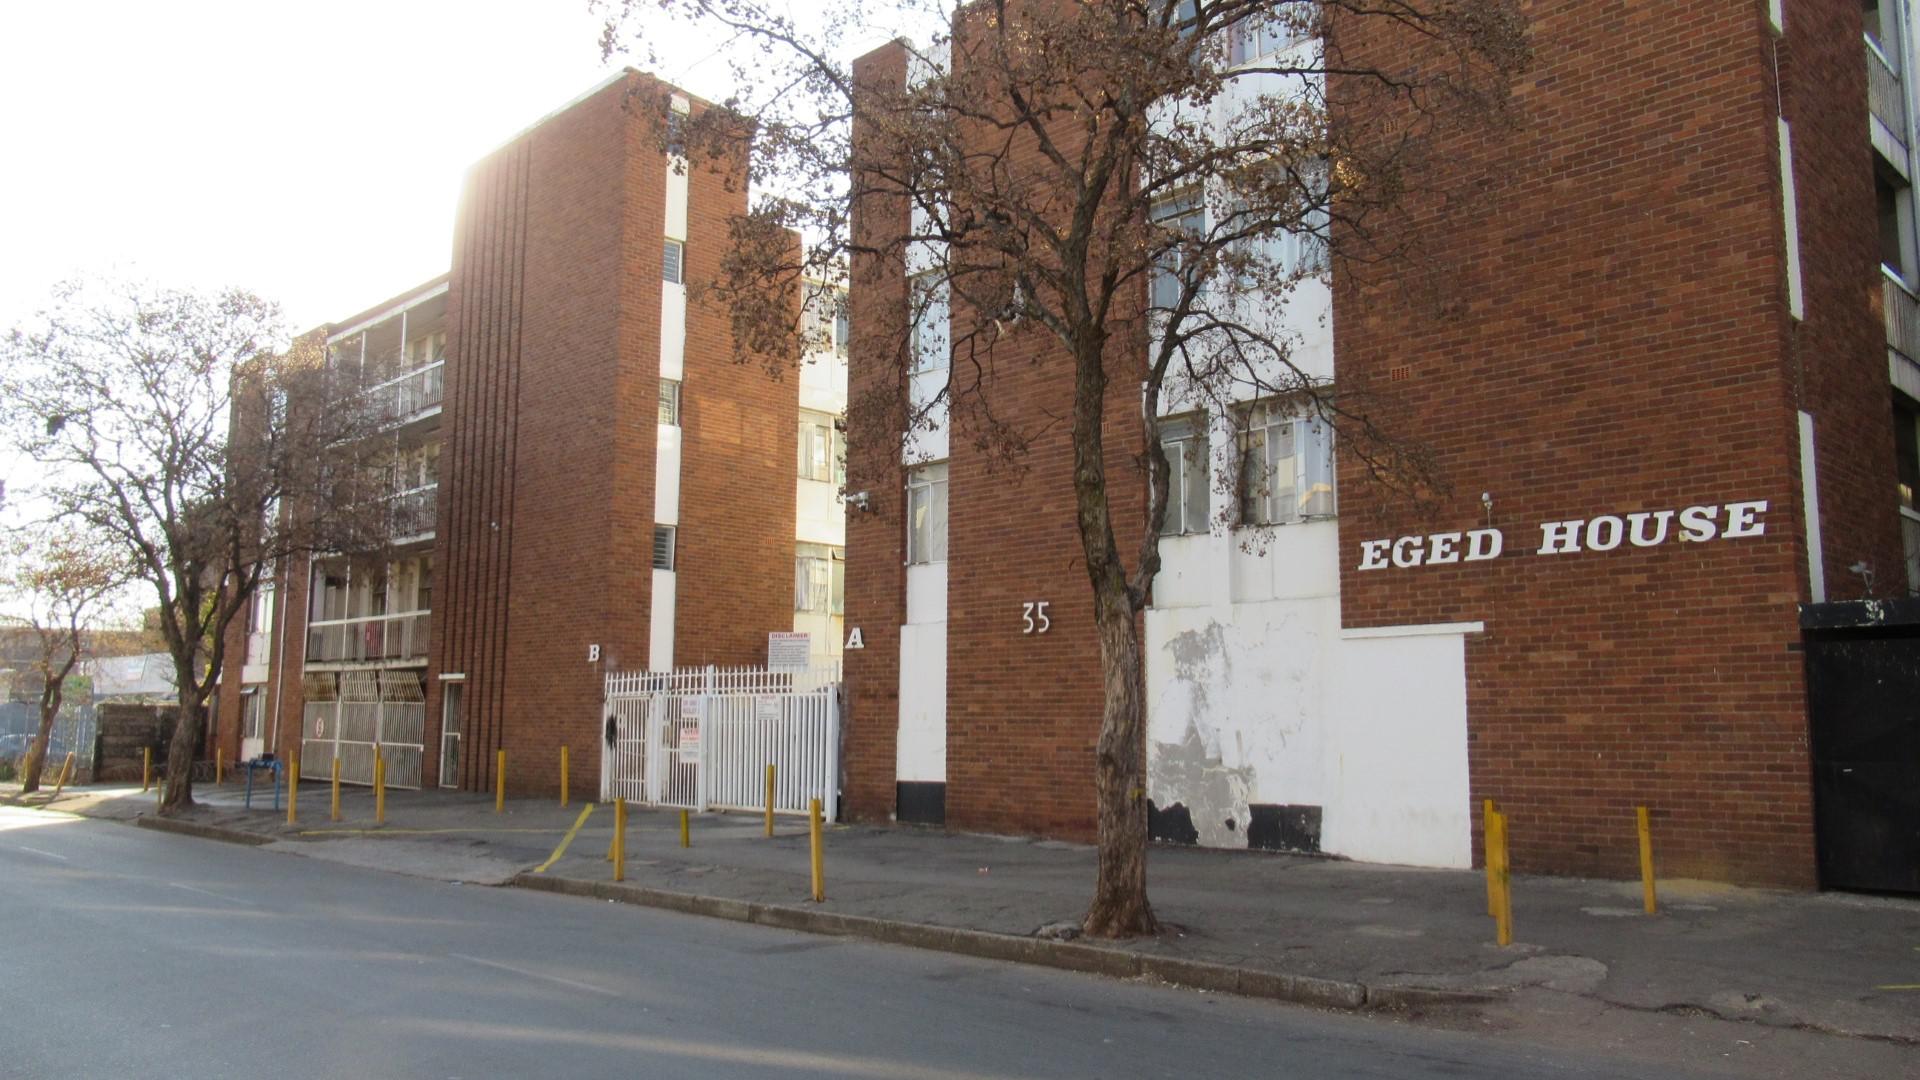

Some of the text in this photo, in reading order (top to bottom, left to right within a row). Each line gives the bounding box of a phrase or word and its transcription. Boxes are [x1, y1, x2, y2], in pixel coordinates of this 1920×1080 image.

[1358, 500, 1768, 570] EGED HOUSE
[1023, 601, 1050, 634] 35
[845, 627, 865, 649] A
[588, 644, 600, 662] B
